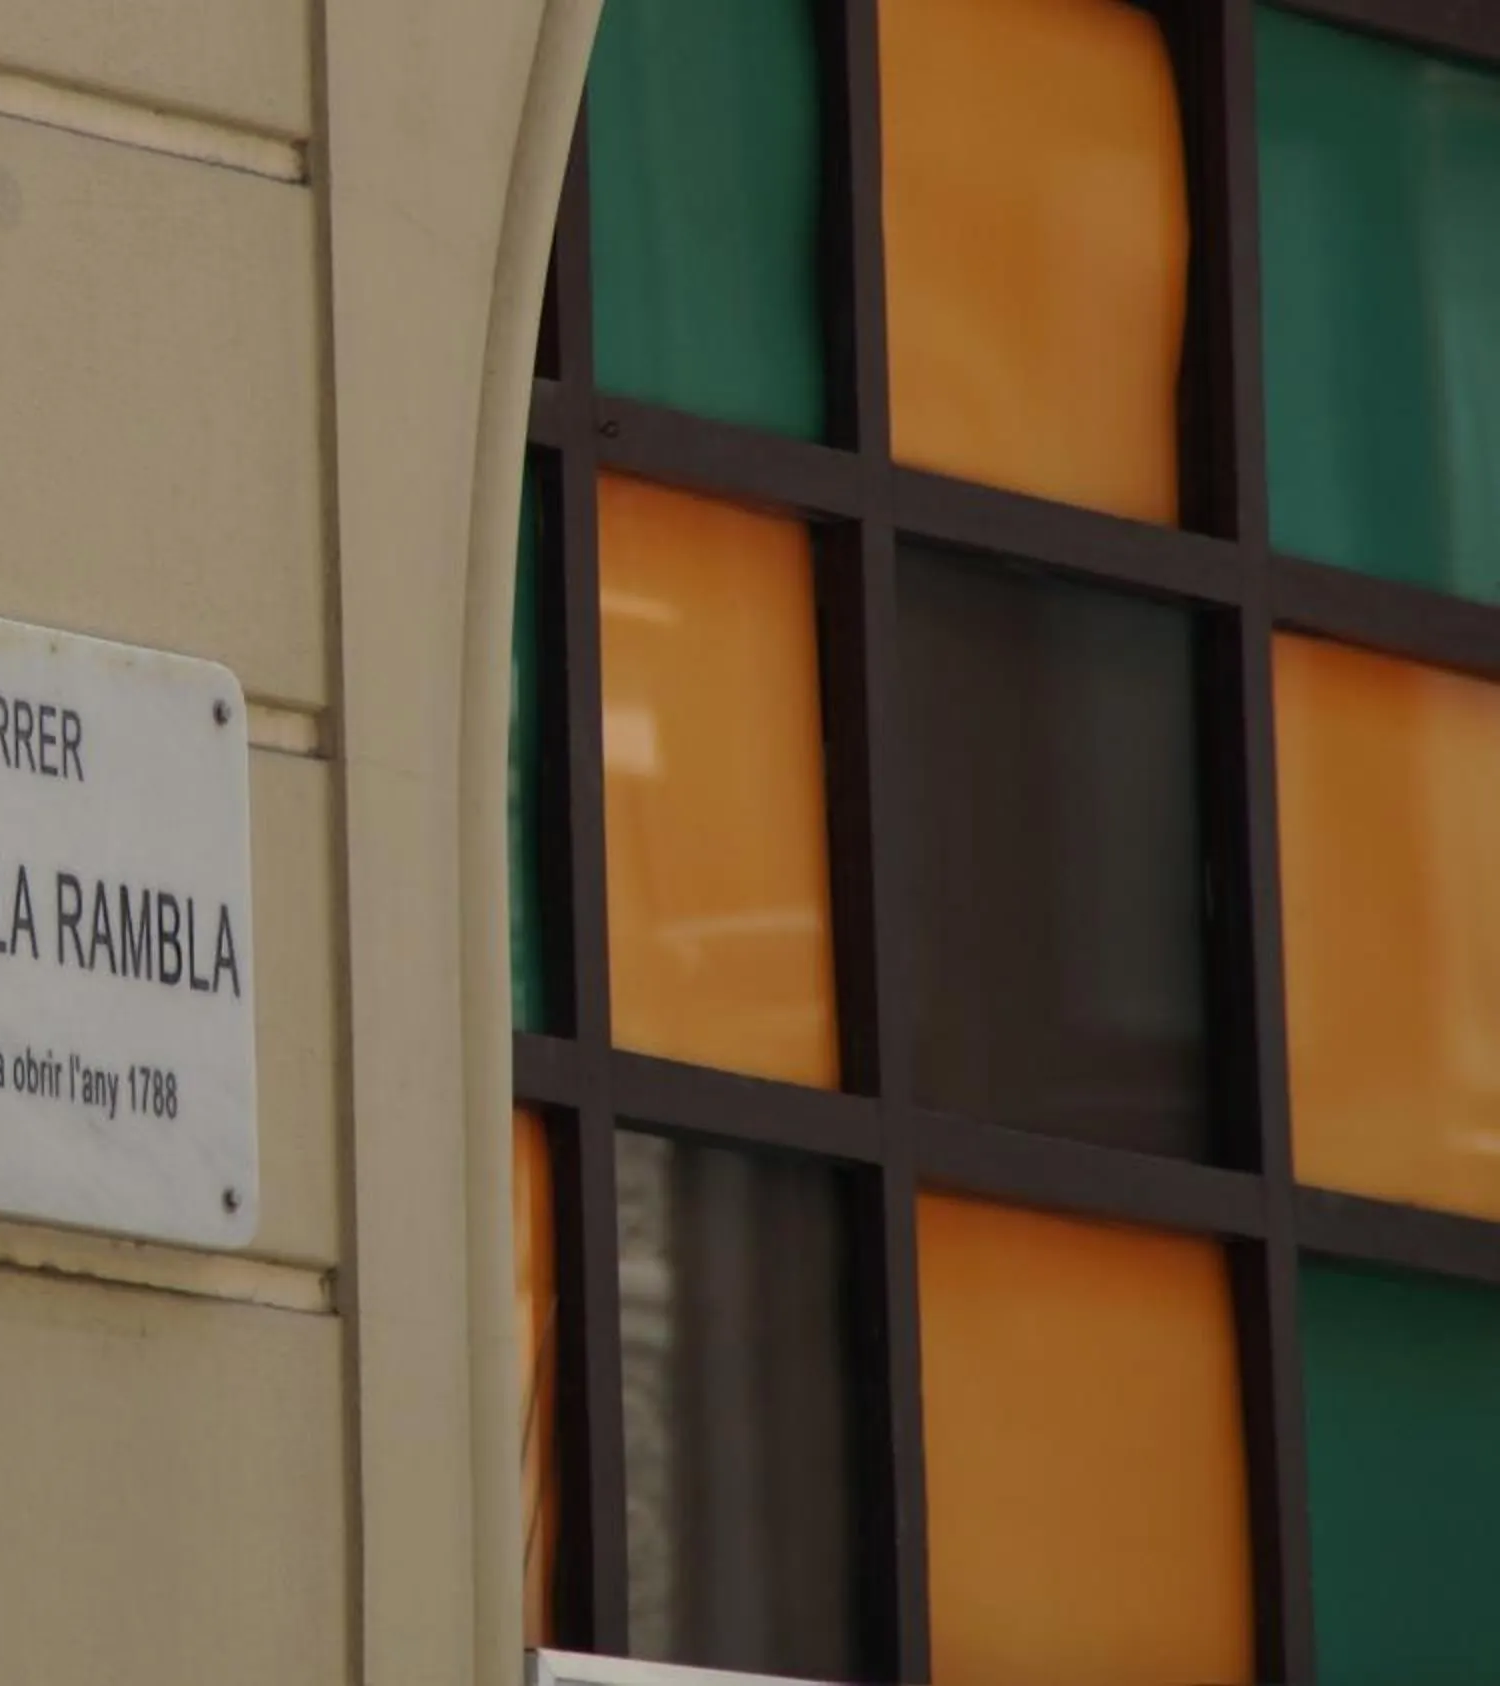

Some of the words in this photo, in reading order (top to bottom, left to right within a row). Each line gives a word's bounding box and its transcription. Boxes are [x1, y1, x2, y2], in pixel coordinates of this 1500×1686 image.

[56, 871, 241, 998] RAMBLA
[13, 1047, 62, 1098] obrir
[69, 1054, 119, 1120] l'any
[128, 1064, 178, 1120] 1788
